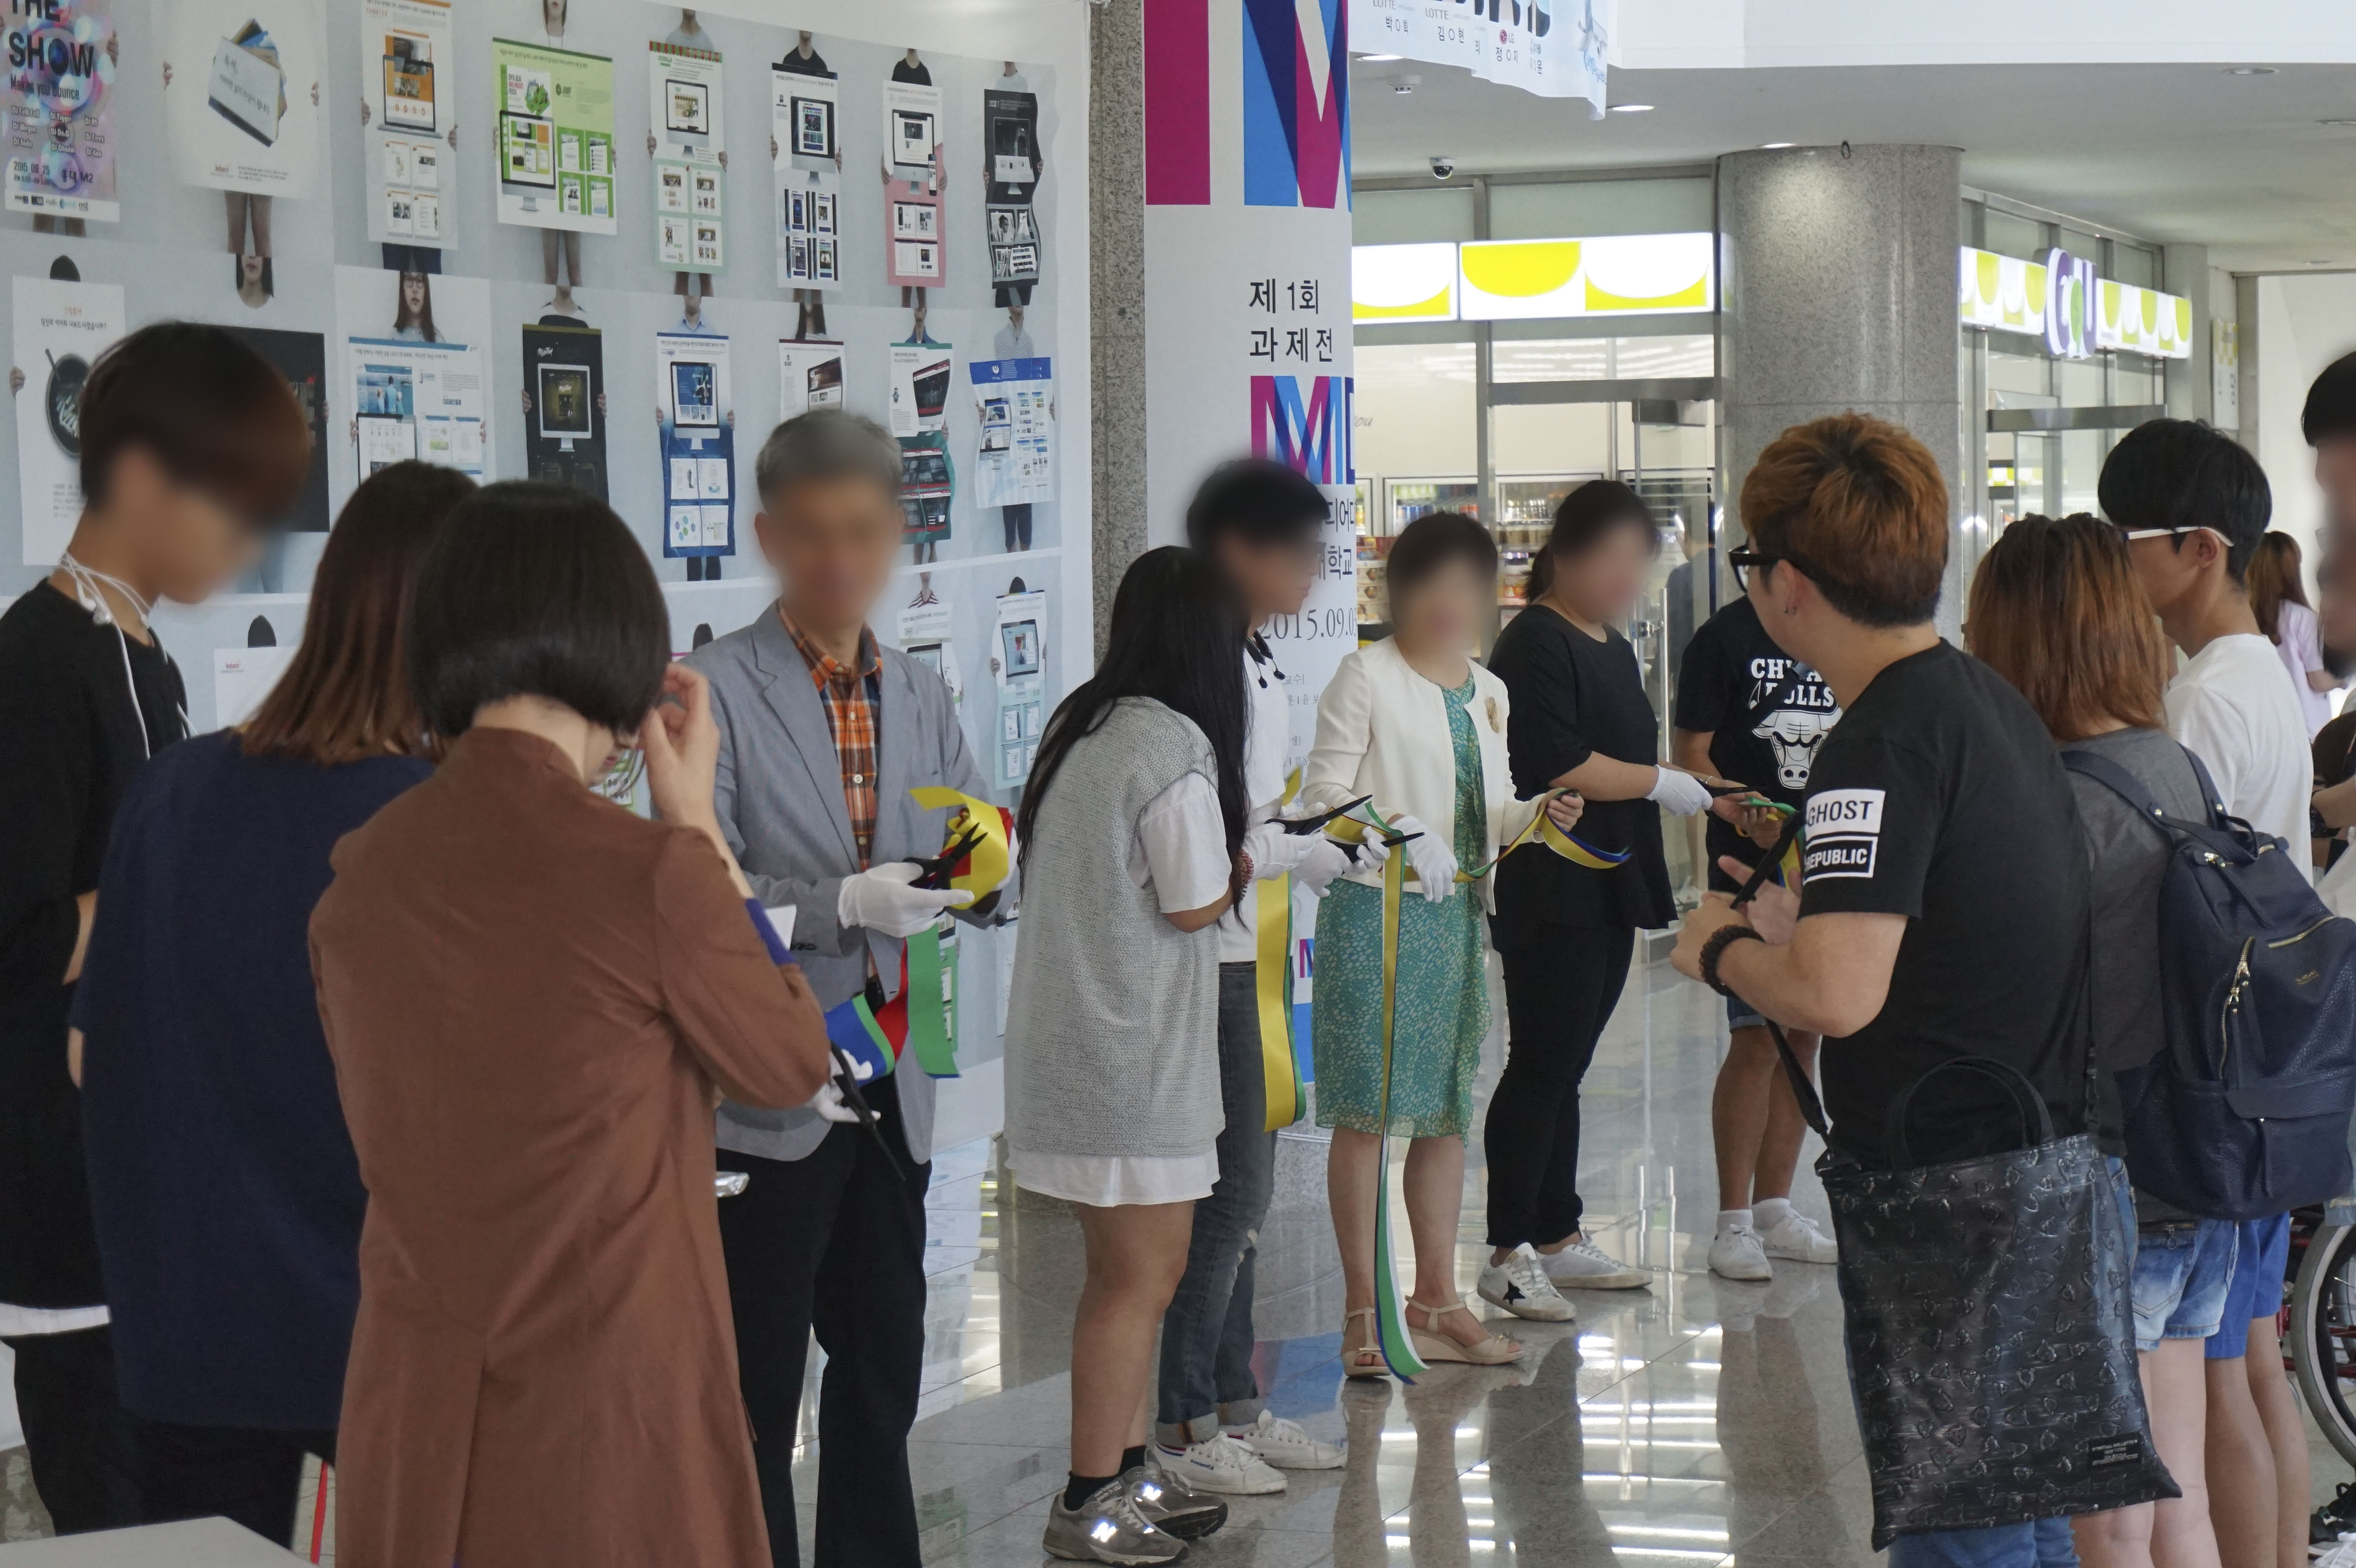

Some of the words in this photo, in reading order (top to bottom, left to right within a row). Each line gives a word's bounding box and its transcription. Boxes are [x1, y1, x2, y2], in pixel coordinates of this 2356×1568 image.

[1373, 0, 1396, 9] LOTTE
[1425, 8, 1449, 19] LOTTE
[9, 32, 94, 78] SHOW
[10, 74, 35, 93] Makes
[37, 83, 50, 97] you
[52, 86, 79, 100] bounce
[12, 106, 18, 115] DJ
[13, 122, 19, 130] DJ
[51, 128, 57, 136] DJ
[13, 138, 19, 146] DJ
[14, 161, 28, 172] 2015
[43, 164, 50, 174] 25
[80, 172, 94, 183] M2
[1249, 278, 1276, 313] 제
[1287, 279, 1319, 314] 1회
[41, 317, 54, 327] 당신의
[55, 318, 68, 327] 아이와
[1249, 327, 1333, 363] 과제전
[1260, 608, 1357, 641] 2015.09.0
[1808, 800, 1874, 827] GHOST
[1805, 848, 1868, 871] REPUBLIC
